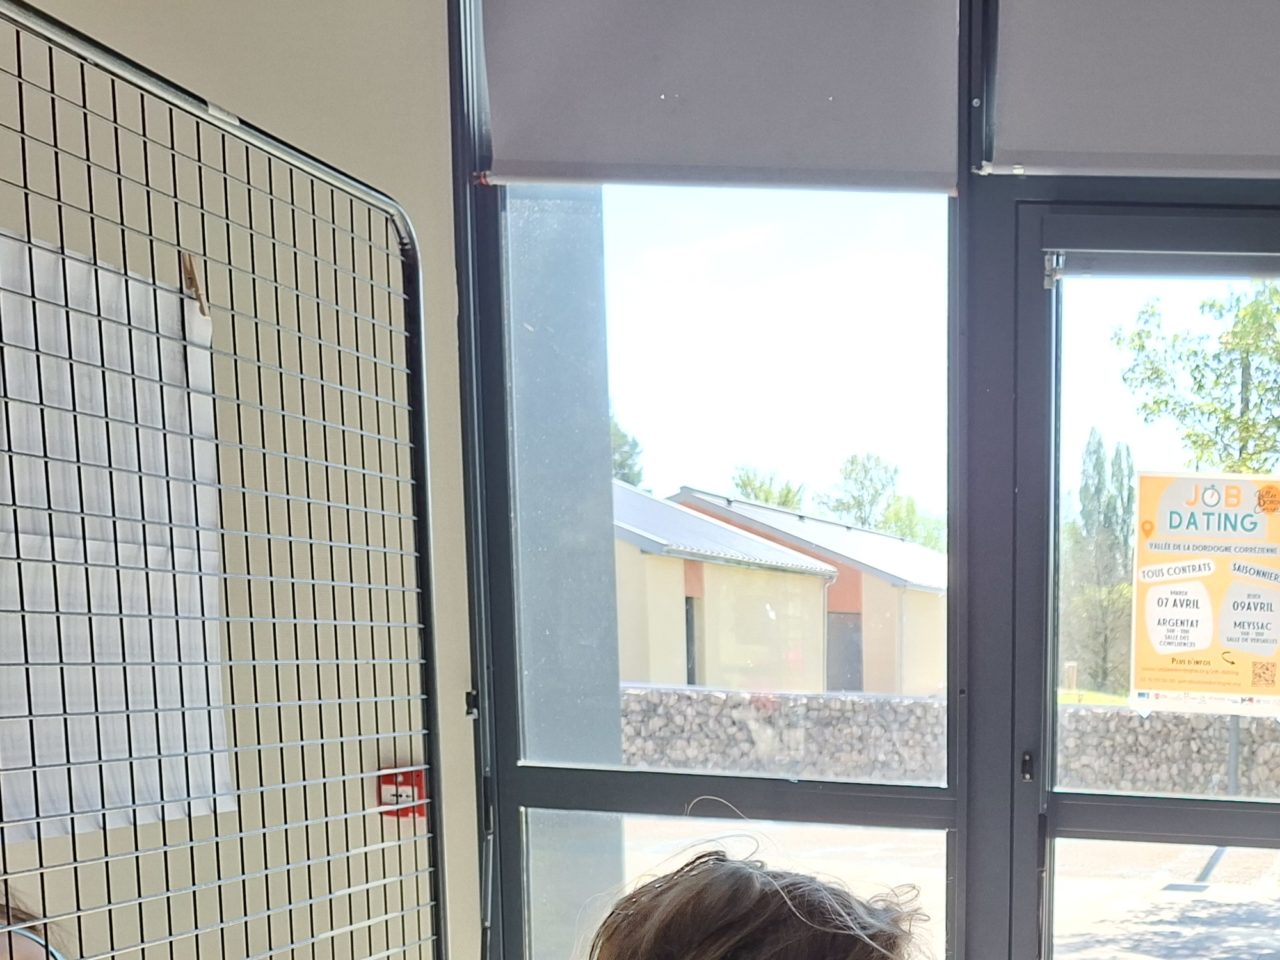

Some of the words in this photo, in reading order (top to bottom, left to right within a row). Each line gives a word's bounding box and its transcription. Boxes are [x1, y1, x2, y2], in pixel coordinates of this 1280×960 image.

[1169, 511, 1258, 532] DATING
[1172, 543, 1181, 551] DE
[1192, 544, 1232, 553] DORDOGNE
[1142, 568, 1165, 580] TOUS
[1166, 563, 1212, 578] CONTRATS
[1157, 598, 1169, 608] 07
[1172, 598, 1200, 609] AVRIL
[1157, 618, 1199, 628] ARGENTAT
[1234, 621, 1272, 631] MEYSSAC
